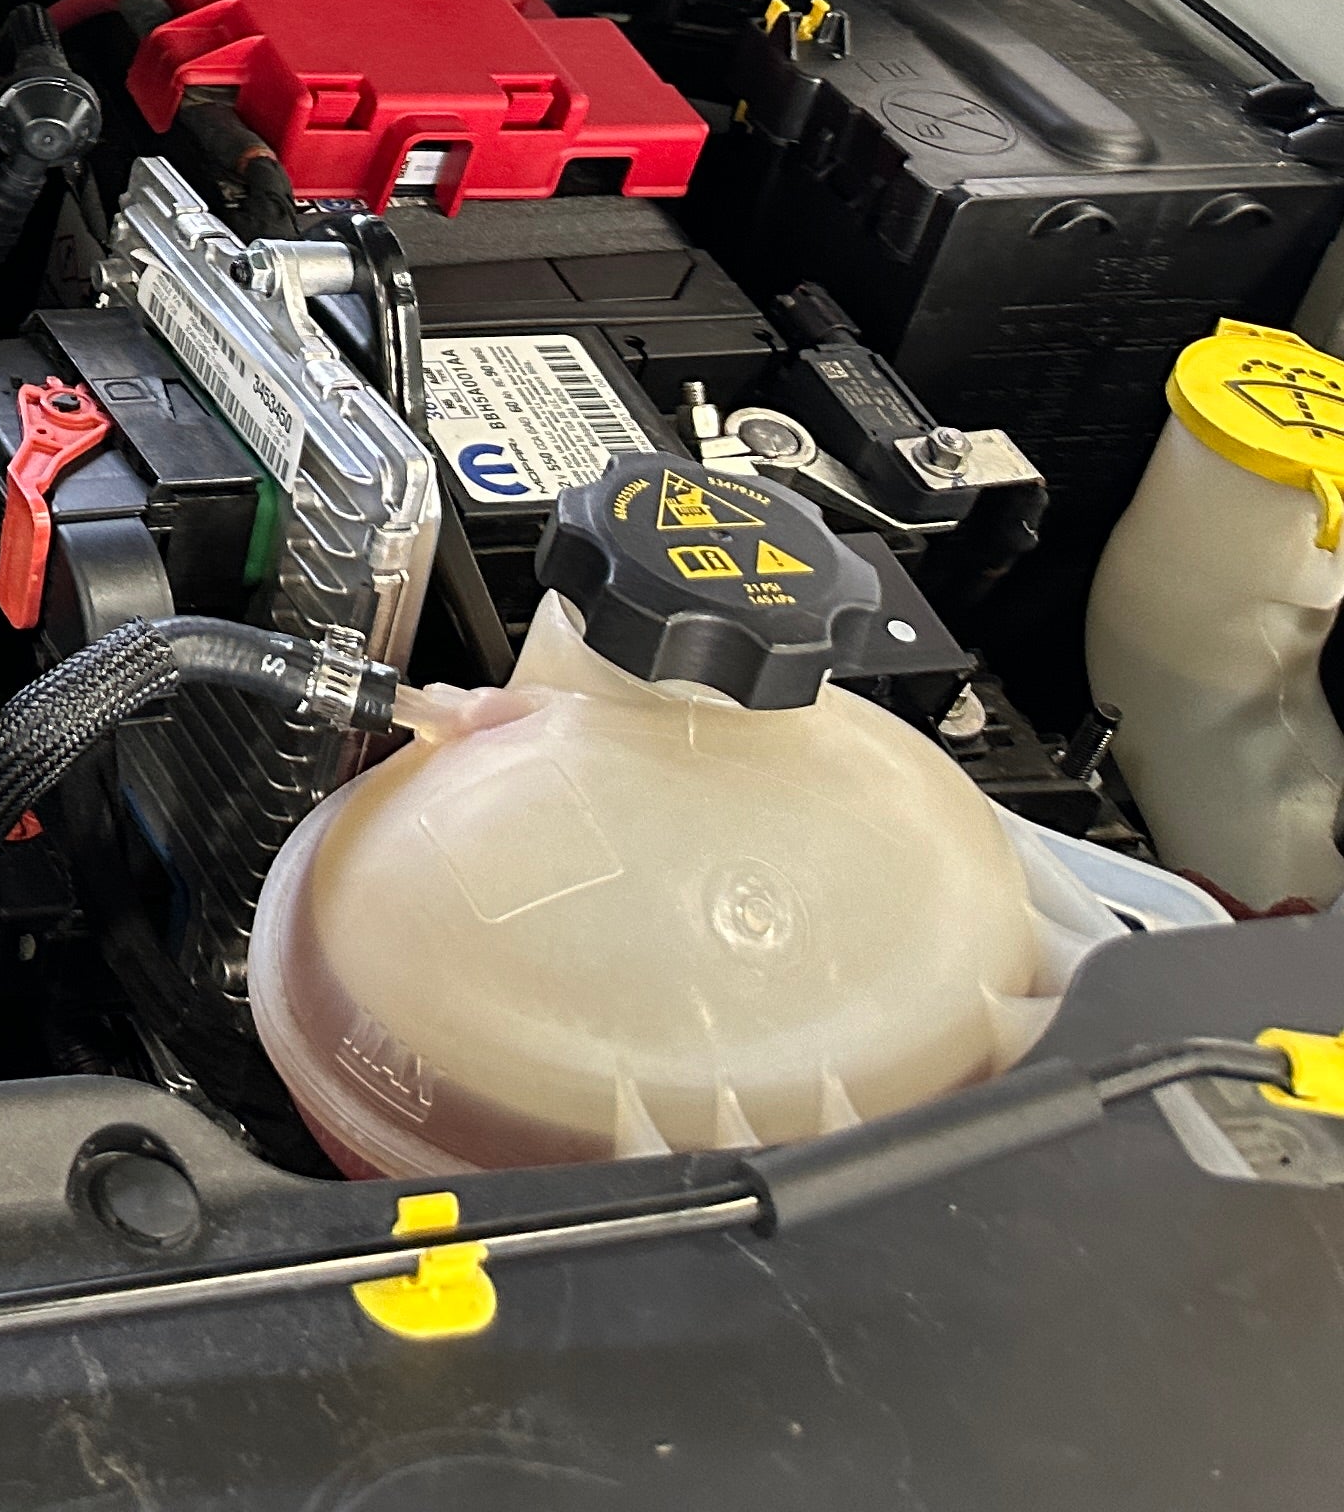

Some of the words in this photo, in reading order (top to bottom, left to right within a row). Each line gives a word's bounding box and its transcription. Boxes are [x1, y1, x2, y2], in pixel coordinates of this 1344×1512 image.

[440, 349, 506, 430] BBH5A001AA
[480, 365, 498, 377] 90
[252, 373, 292, 434] 3453450
[505, 401, 523, 413] 60
[541, 452, 562, 471] 550
[343, 1012, 434, 1106] MAX
